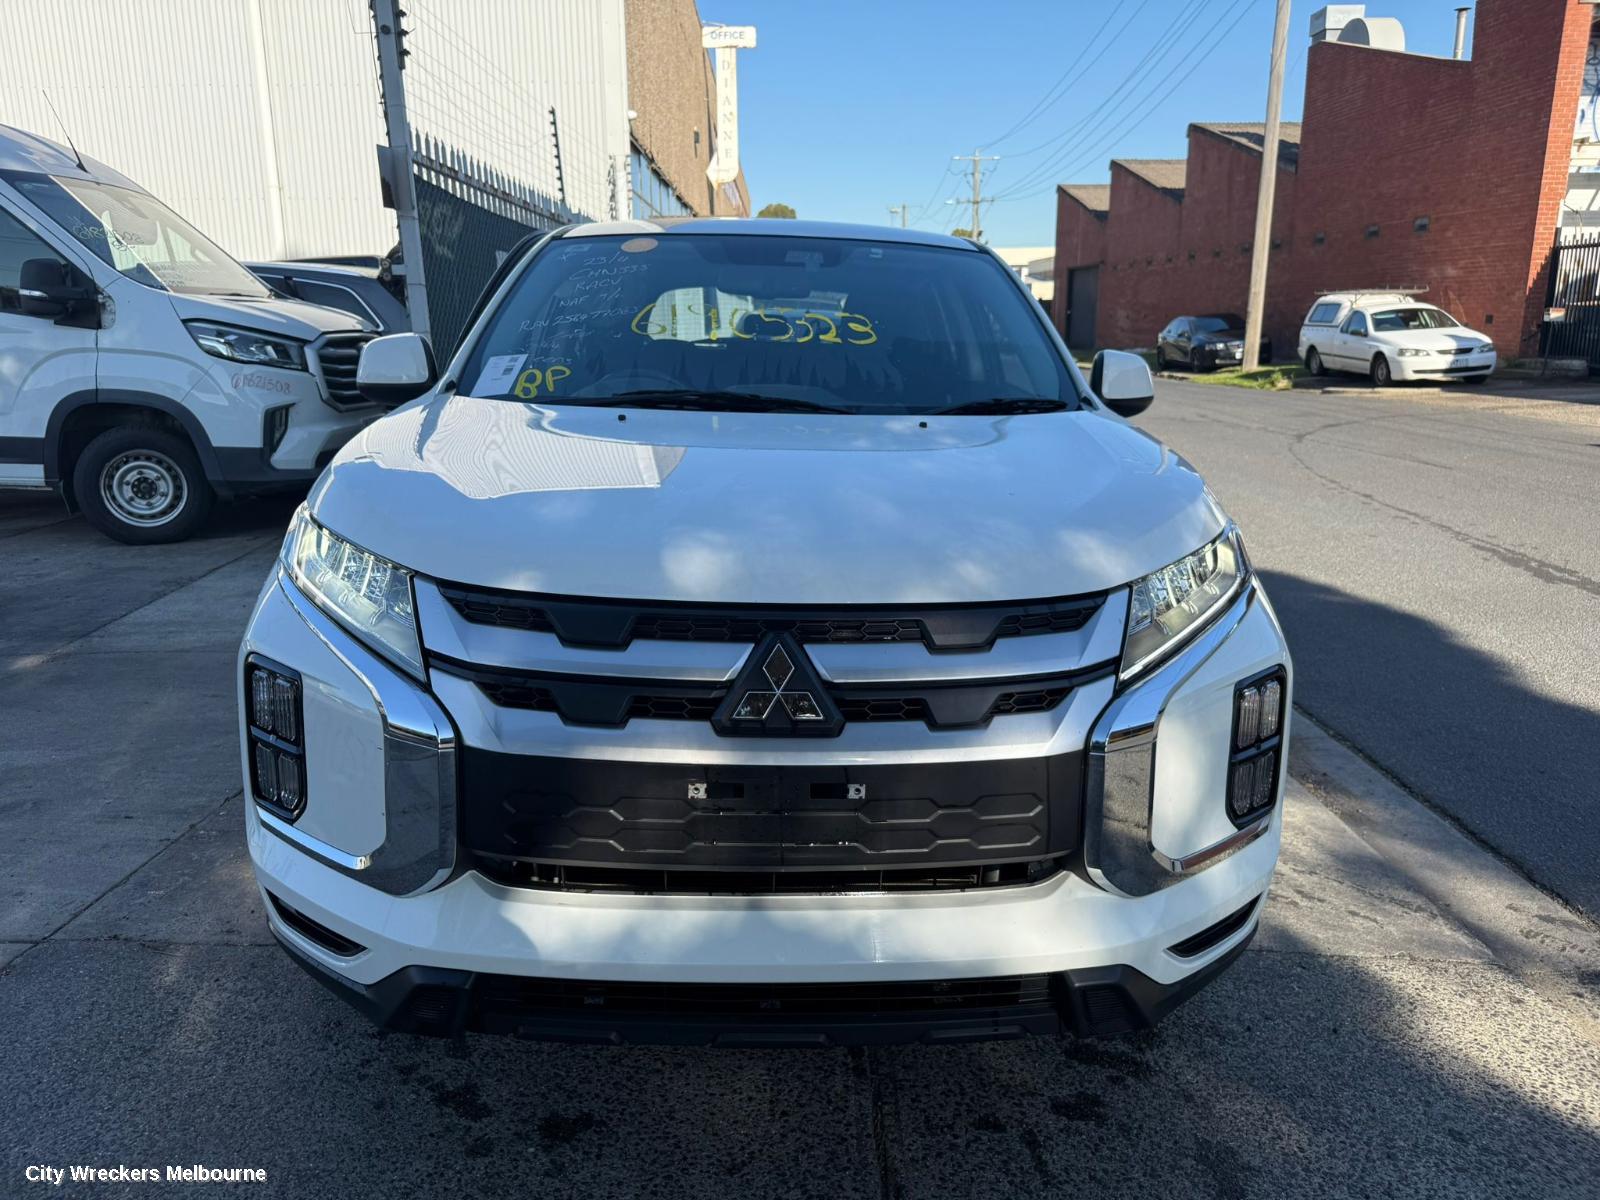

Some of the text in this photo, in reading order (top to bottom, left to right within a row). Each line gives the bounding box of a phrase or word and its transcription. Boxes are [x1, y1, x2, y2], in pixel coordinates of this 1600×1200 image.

[710, 31, 745, 40] OFFICE
[721, 59, 734, 160] DIANNE
[514, 365, 572, 399] BP
